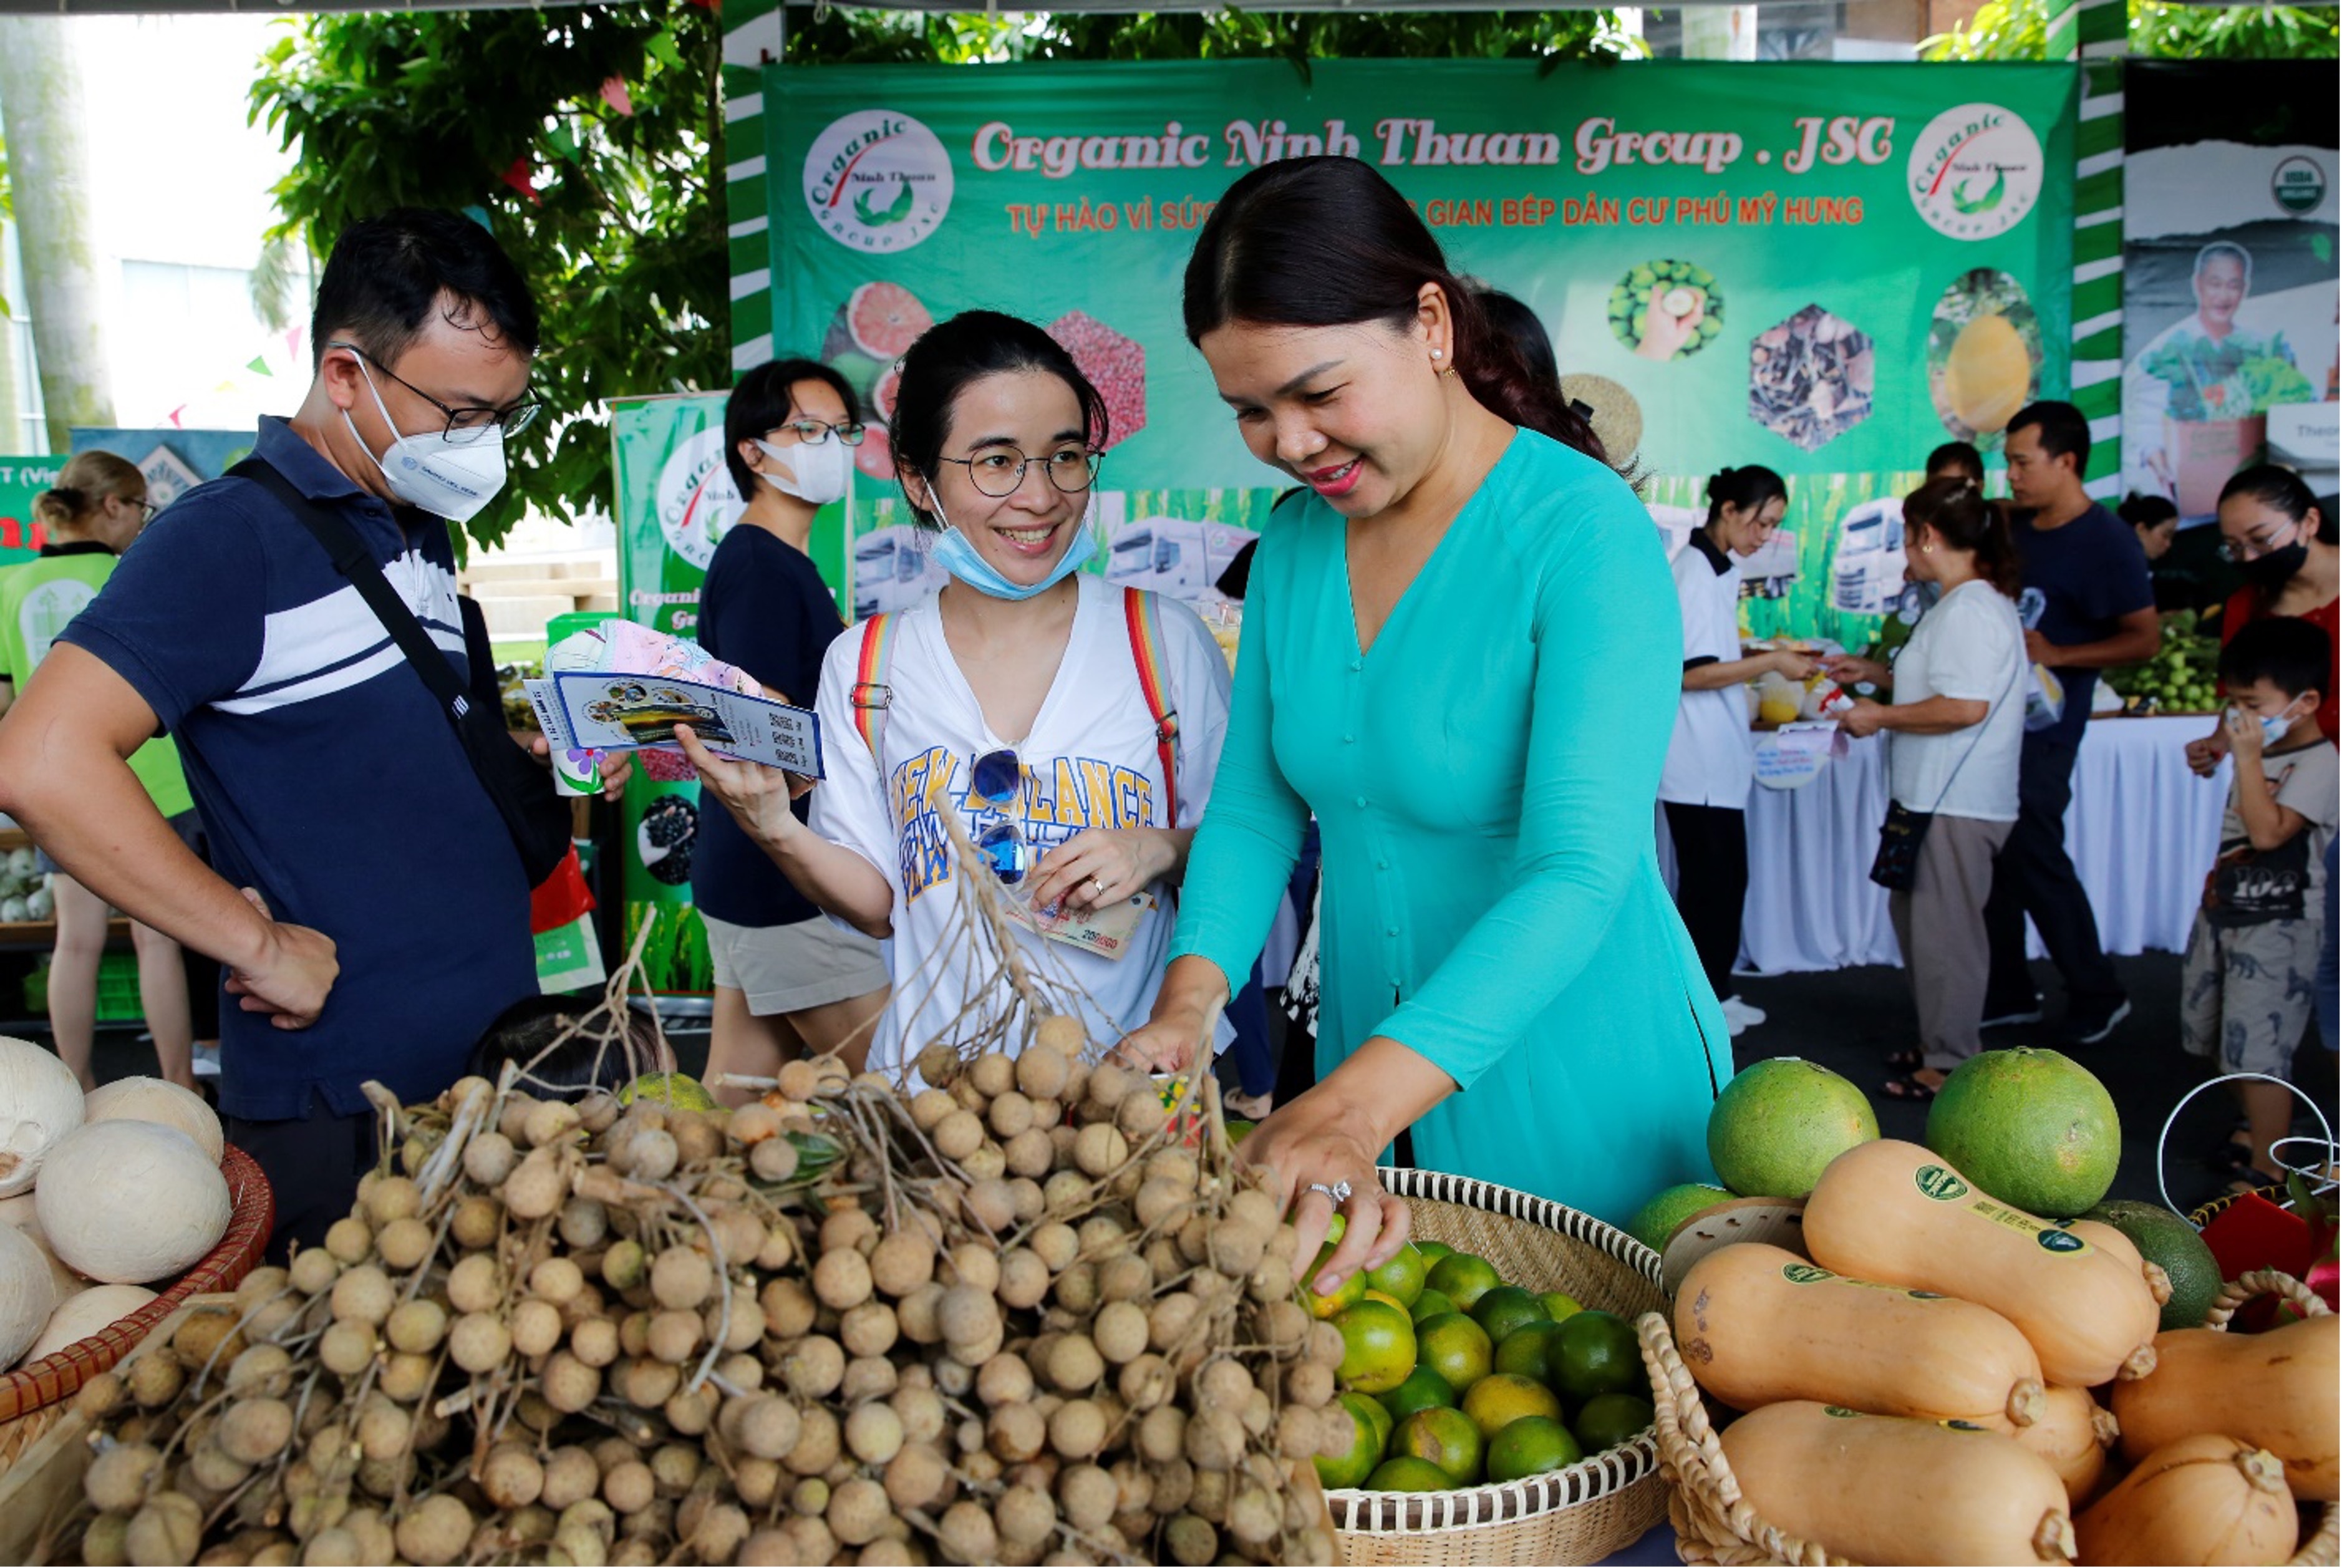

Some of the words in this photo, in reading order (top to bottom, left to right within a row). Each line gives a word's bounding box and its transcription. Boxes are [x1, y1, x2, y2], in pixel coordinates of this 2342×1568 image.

[811, 119, 906, 205] Organic
[972, 121, 1209, 178] Organic
[1224, 119, 1360, 166] Ninh
[1375, 117, 1561, 165] Thuan
[1574, 117, 1743, 175] Group
[1783, 116, 1895, 174] JSC
[1005, 204, 1049, 239] TỰ
[1055, 196, 1120, 231] HÀO
[1122, 195, 1154, 231] VÌ
[1426, 198, 1493, 226] GIAN
[1501, 192, 1556, 226] BẾP
[1563, 190, 1620, 226] DÂN
[1627, 196, 1670, 224] CƯ
[1675, 190, 1731, 224] PHÚ
[1738, 190, 1778, 225] MỸ
[1783, 196, 1864, 225] HƯNG
[629, 588, 700, 607] Organi
[949, 753, 1154, 830] LANCE
